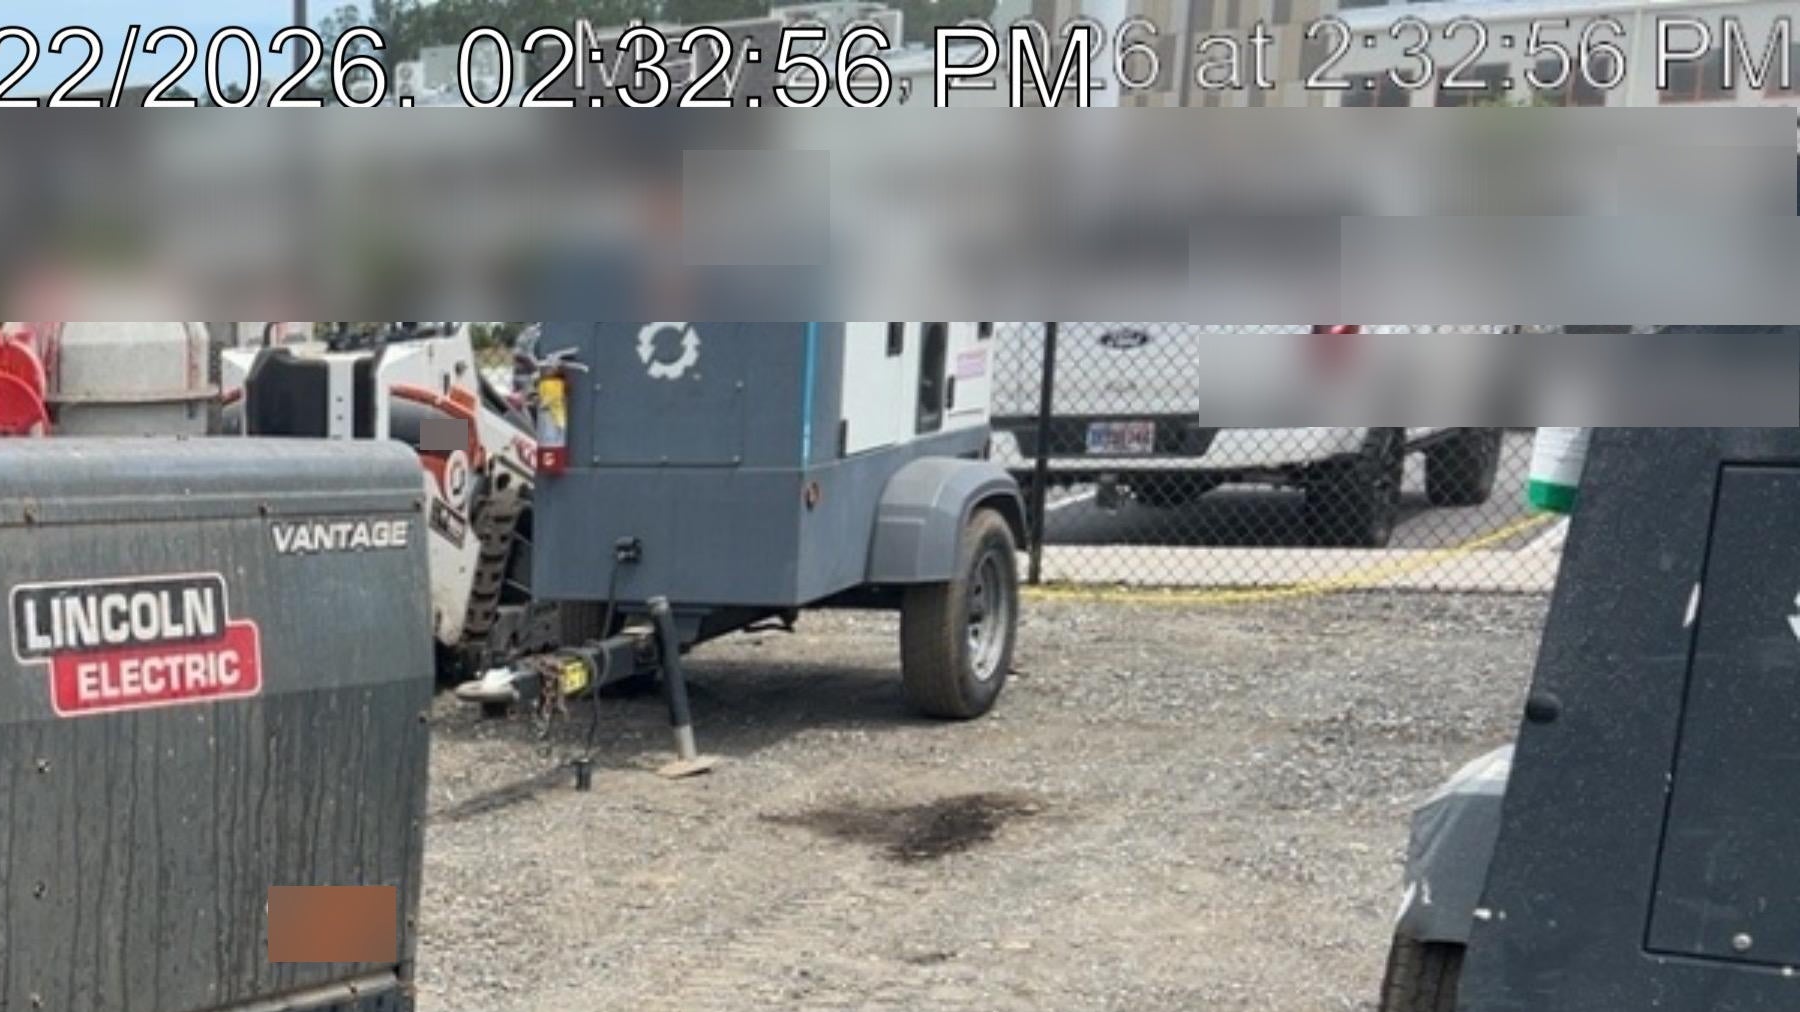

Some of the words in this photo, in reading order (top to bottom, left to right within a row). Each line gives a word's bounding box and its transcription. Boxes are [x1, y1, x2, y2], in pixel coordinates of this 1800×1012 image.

[272, 520, 410, 554] VANTAGE
[23, 586, 217, 650] LINCOLN
[76, 649, 241, 701] ELECTRIC
